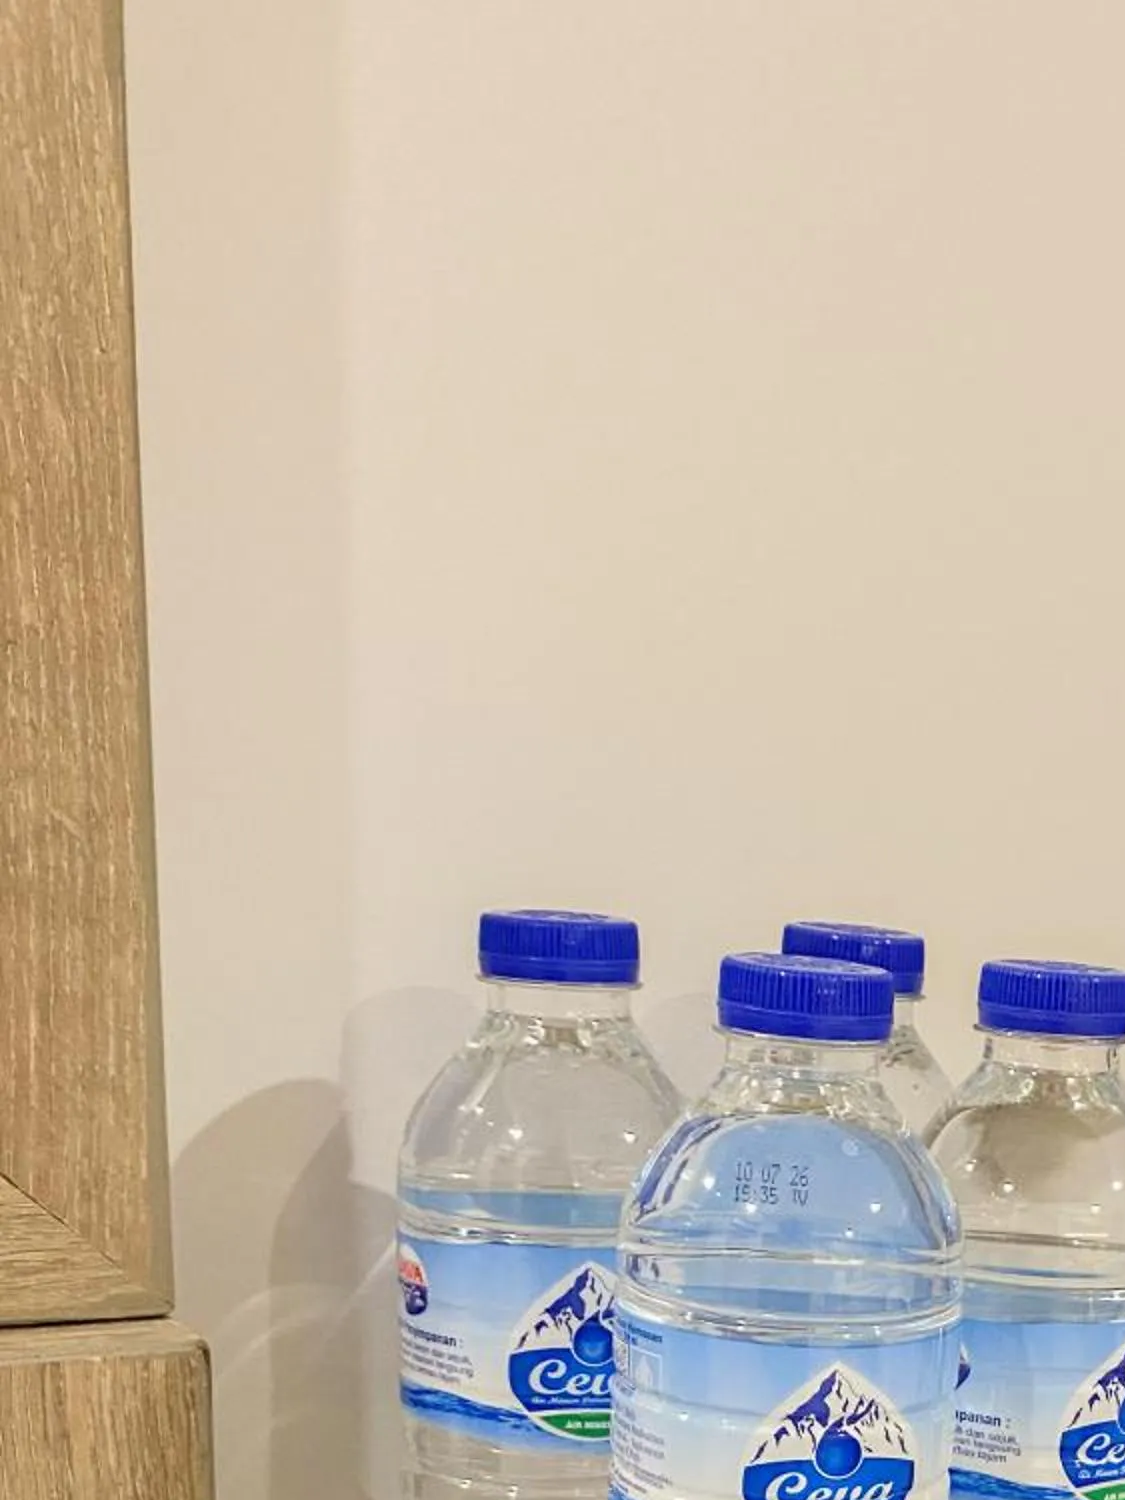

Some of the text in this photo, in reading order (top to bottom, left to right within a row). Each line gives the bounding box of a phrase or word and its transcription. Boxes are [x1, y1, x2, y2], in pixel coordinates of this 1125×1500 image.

[735, 1161, 809, 1187] 10 07 26
[734, 1184, 778, 1205] 15:35
[528, 1359, 614, 1396] Cev
